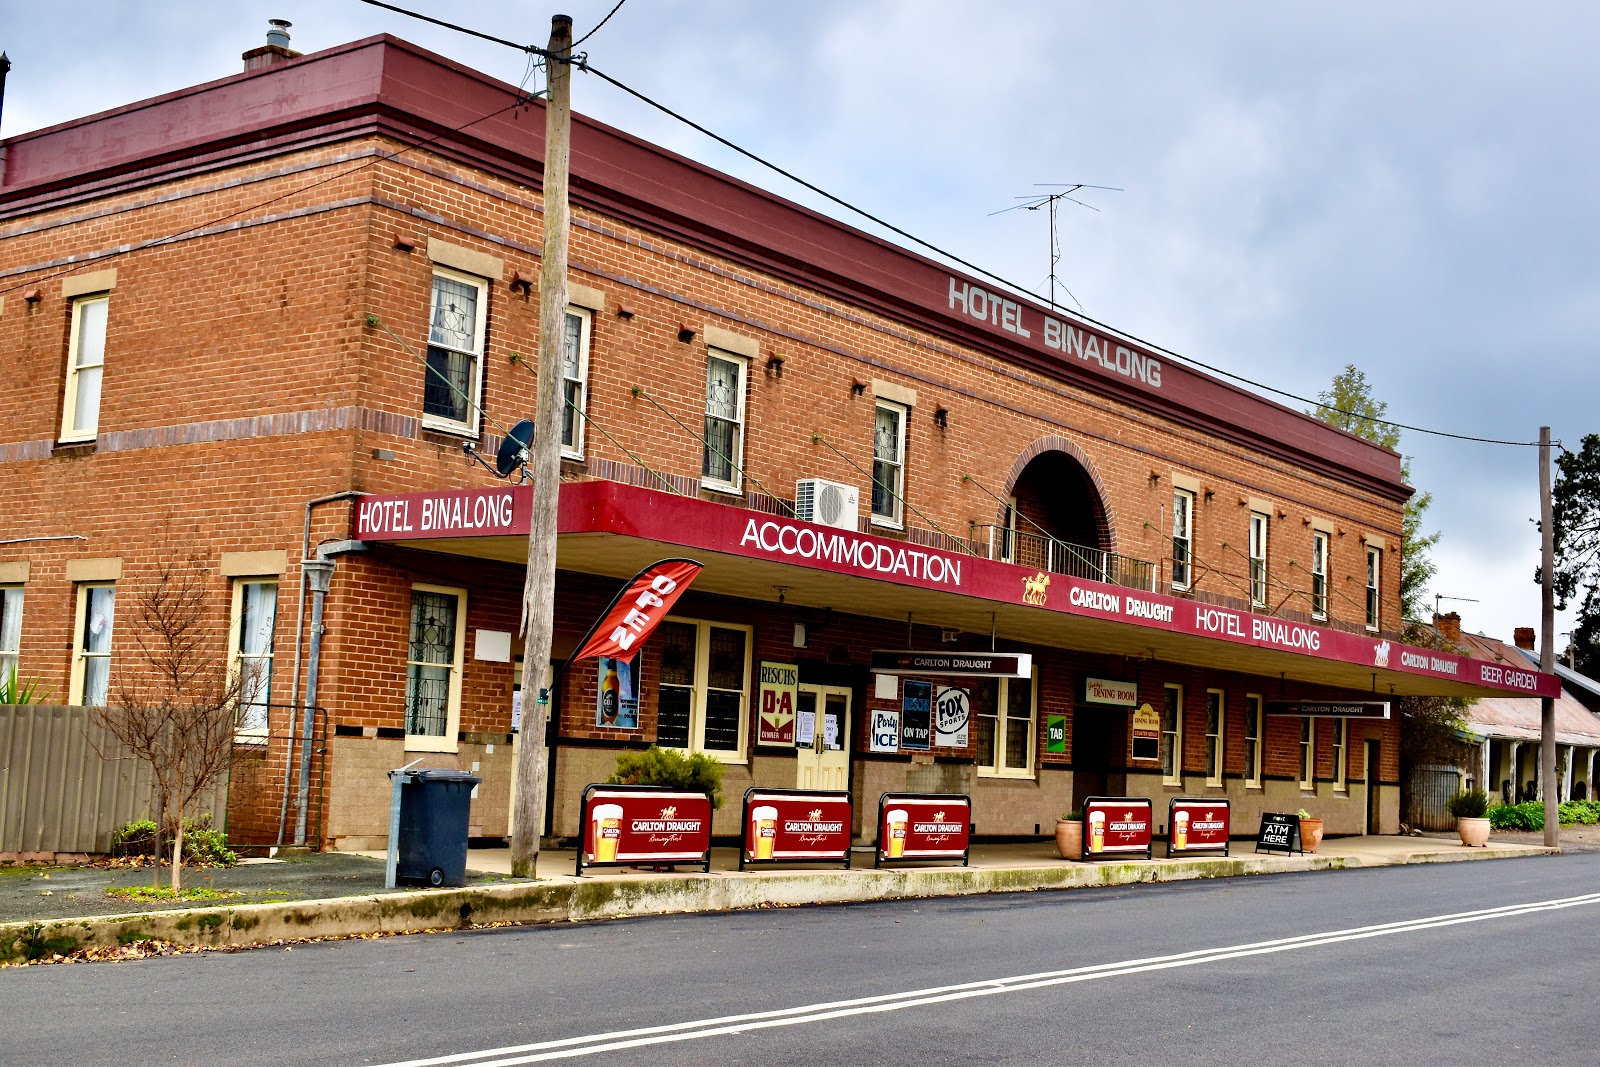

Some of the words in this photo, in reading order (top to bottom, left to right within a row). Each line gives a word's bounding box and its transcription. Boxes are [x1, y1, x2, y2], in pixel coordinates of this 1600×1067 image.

[949, 278, 1030, 338] HOTEL
[1044, 316, 1162, 388] BINALONG
[358, 500, 413, 533] HOTEL
[421, 494, 513, 531] BINALONG
[740, 518, 961, 585] ACCOMMODATION
[1070, 587, 1120, 613] CARLTON
[1126, 596, 1174, 623] DRAUGHT
[609, 575, 677, 651] OPEN
[1196, 608, 1246, 638] HOTEL
[1252, 619, 1320, 650] BINALONG
[914, 658, 950, 667] CARLTON
[952, 658, 992, 668] DRAUGHT
[1401, 652, 1428, 670] CARLTON
[1431, 656, 1458, 675] DRAUGHT
[761, 666, 796, 685] RESCHS
[1481, 665, 1502, 684] BEER
[1505, 670, 1538, 690] GARDEN
[1094, 688, 1116, 699] DINING
[1118, 690, 1134, 701] ROOM
[938, 694, 964, 721] FOX
[877, 714, 898, 733] Party
[940, 714, 966, 728] SPORTS
[762, 730, 780, 739] DINNER
[784, 732, 792, 740] ALE
[904, 726, 914, 738] ON
[915, 728, 928, 739] TAP
[1050, 728, 1063, 740] TAB
[876, 734, 897, 746] ICE
[632, 821, 665, 831] CARLTON
[666, 822, 702, 831] DRAUGHT
[784, 822, 812, 831] CARLTON
[814, 823, 843, 832] DRAUGHT
[914, 824, 937, 832] CARLTON
[938, 824, 962, 832] DRAUGHT
[1109, 822, 1127, 830] CARLTON
[1265, 825, 1288, 835] ATM
[1263, 834, 1288, 844] HERE
